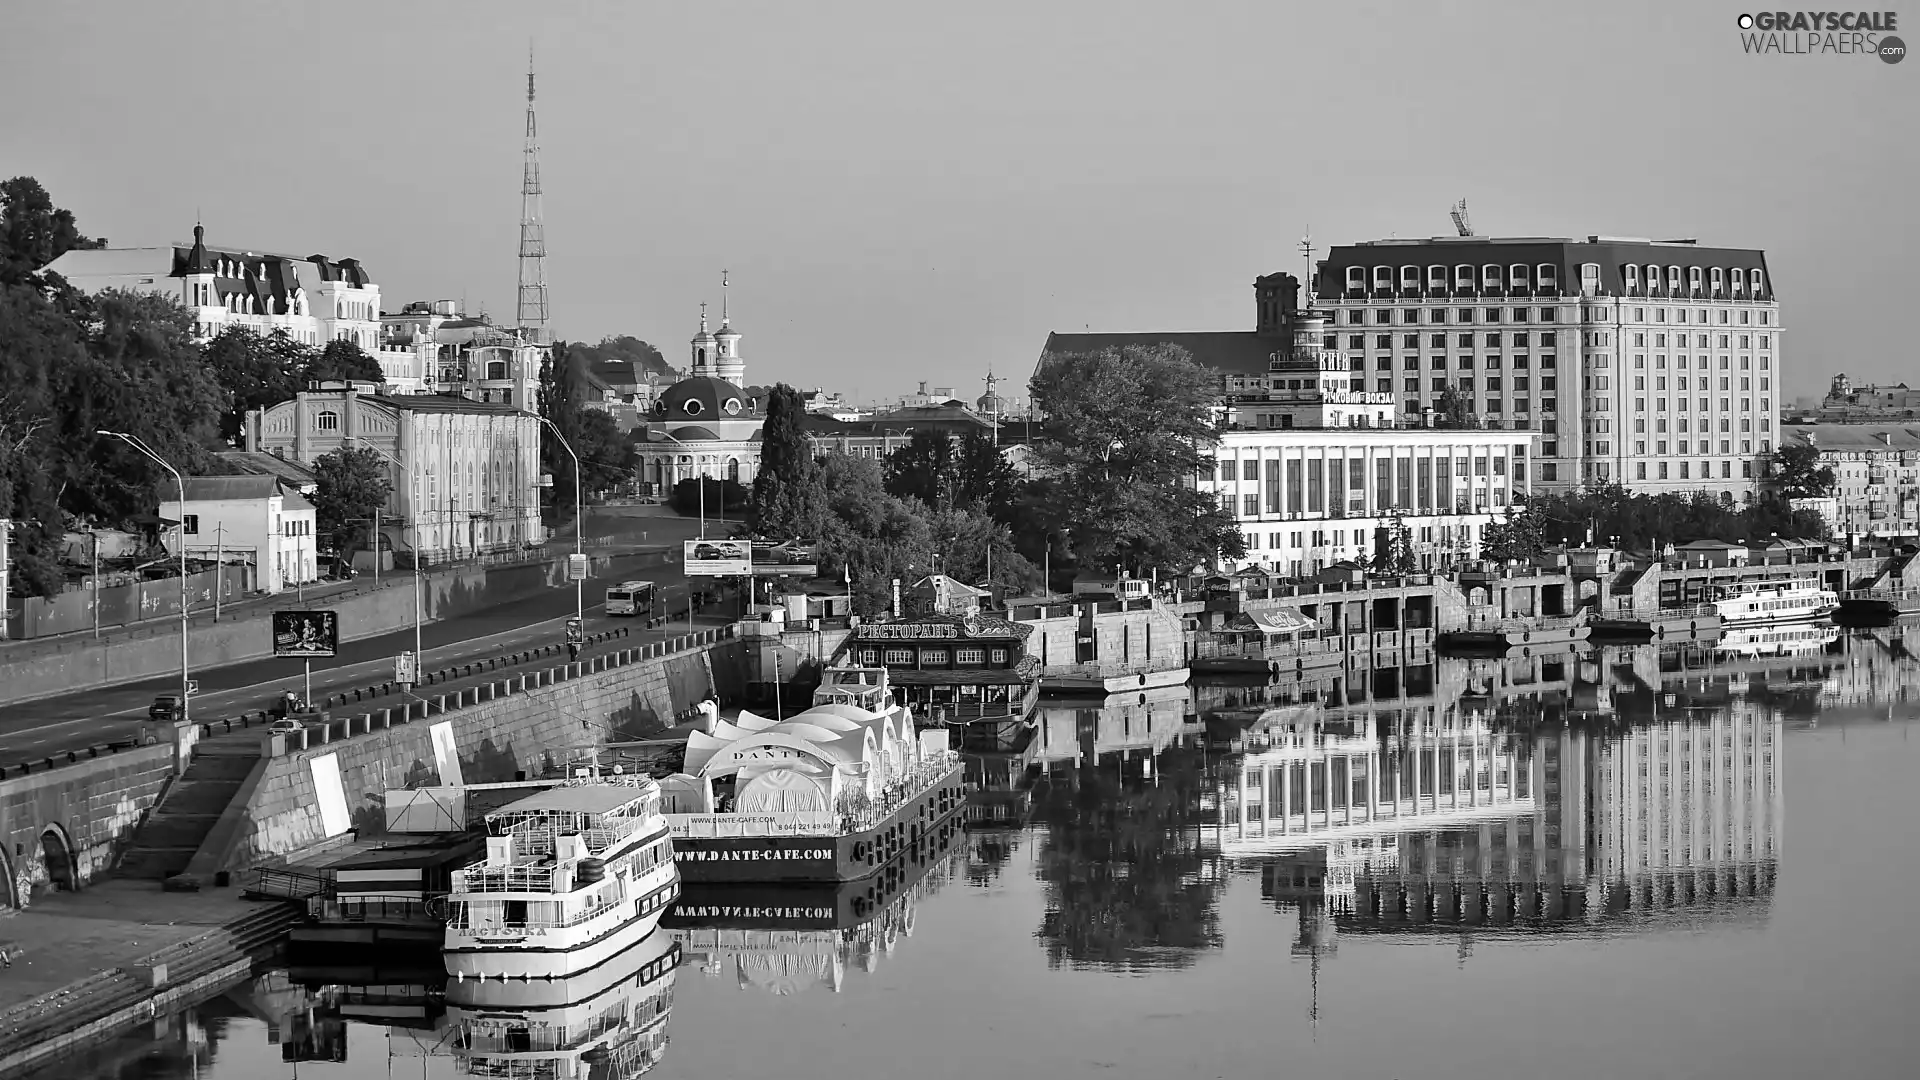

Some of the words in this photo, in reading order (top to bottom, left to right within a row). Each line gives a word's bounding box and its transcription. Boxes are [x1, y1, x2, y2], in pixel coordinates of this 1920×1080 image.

[1365, 392, 1396, 404] ВОКЗАЛ
[857, 623, 958, 639] РЕСТОРАНЪ
[733, 750, 806, 760] DANTE
[690, 816, 776, 824] WWW.DANTE-CAFE.COM
[673, 849, 832, 862] WWW.DANTE-CAFE.COM
